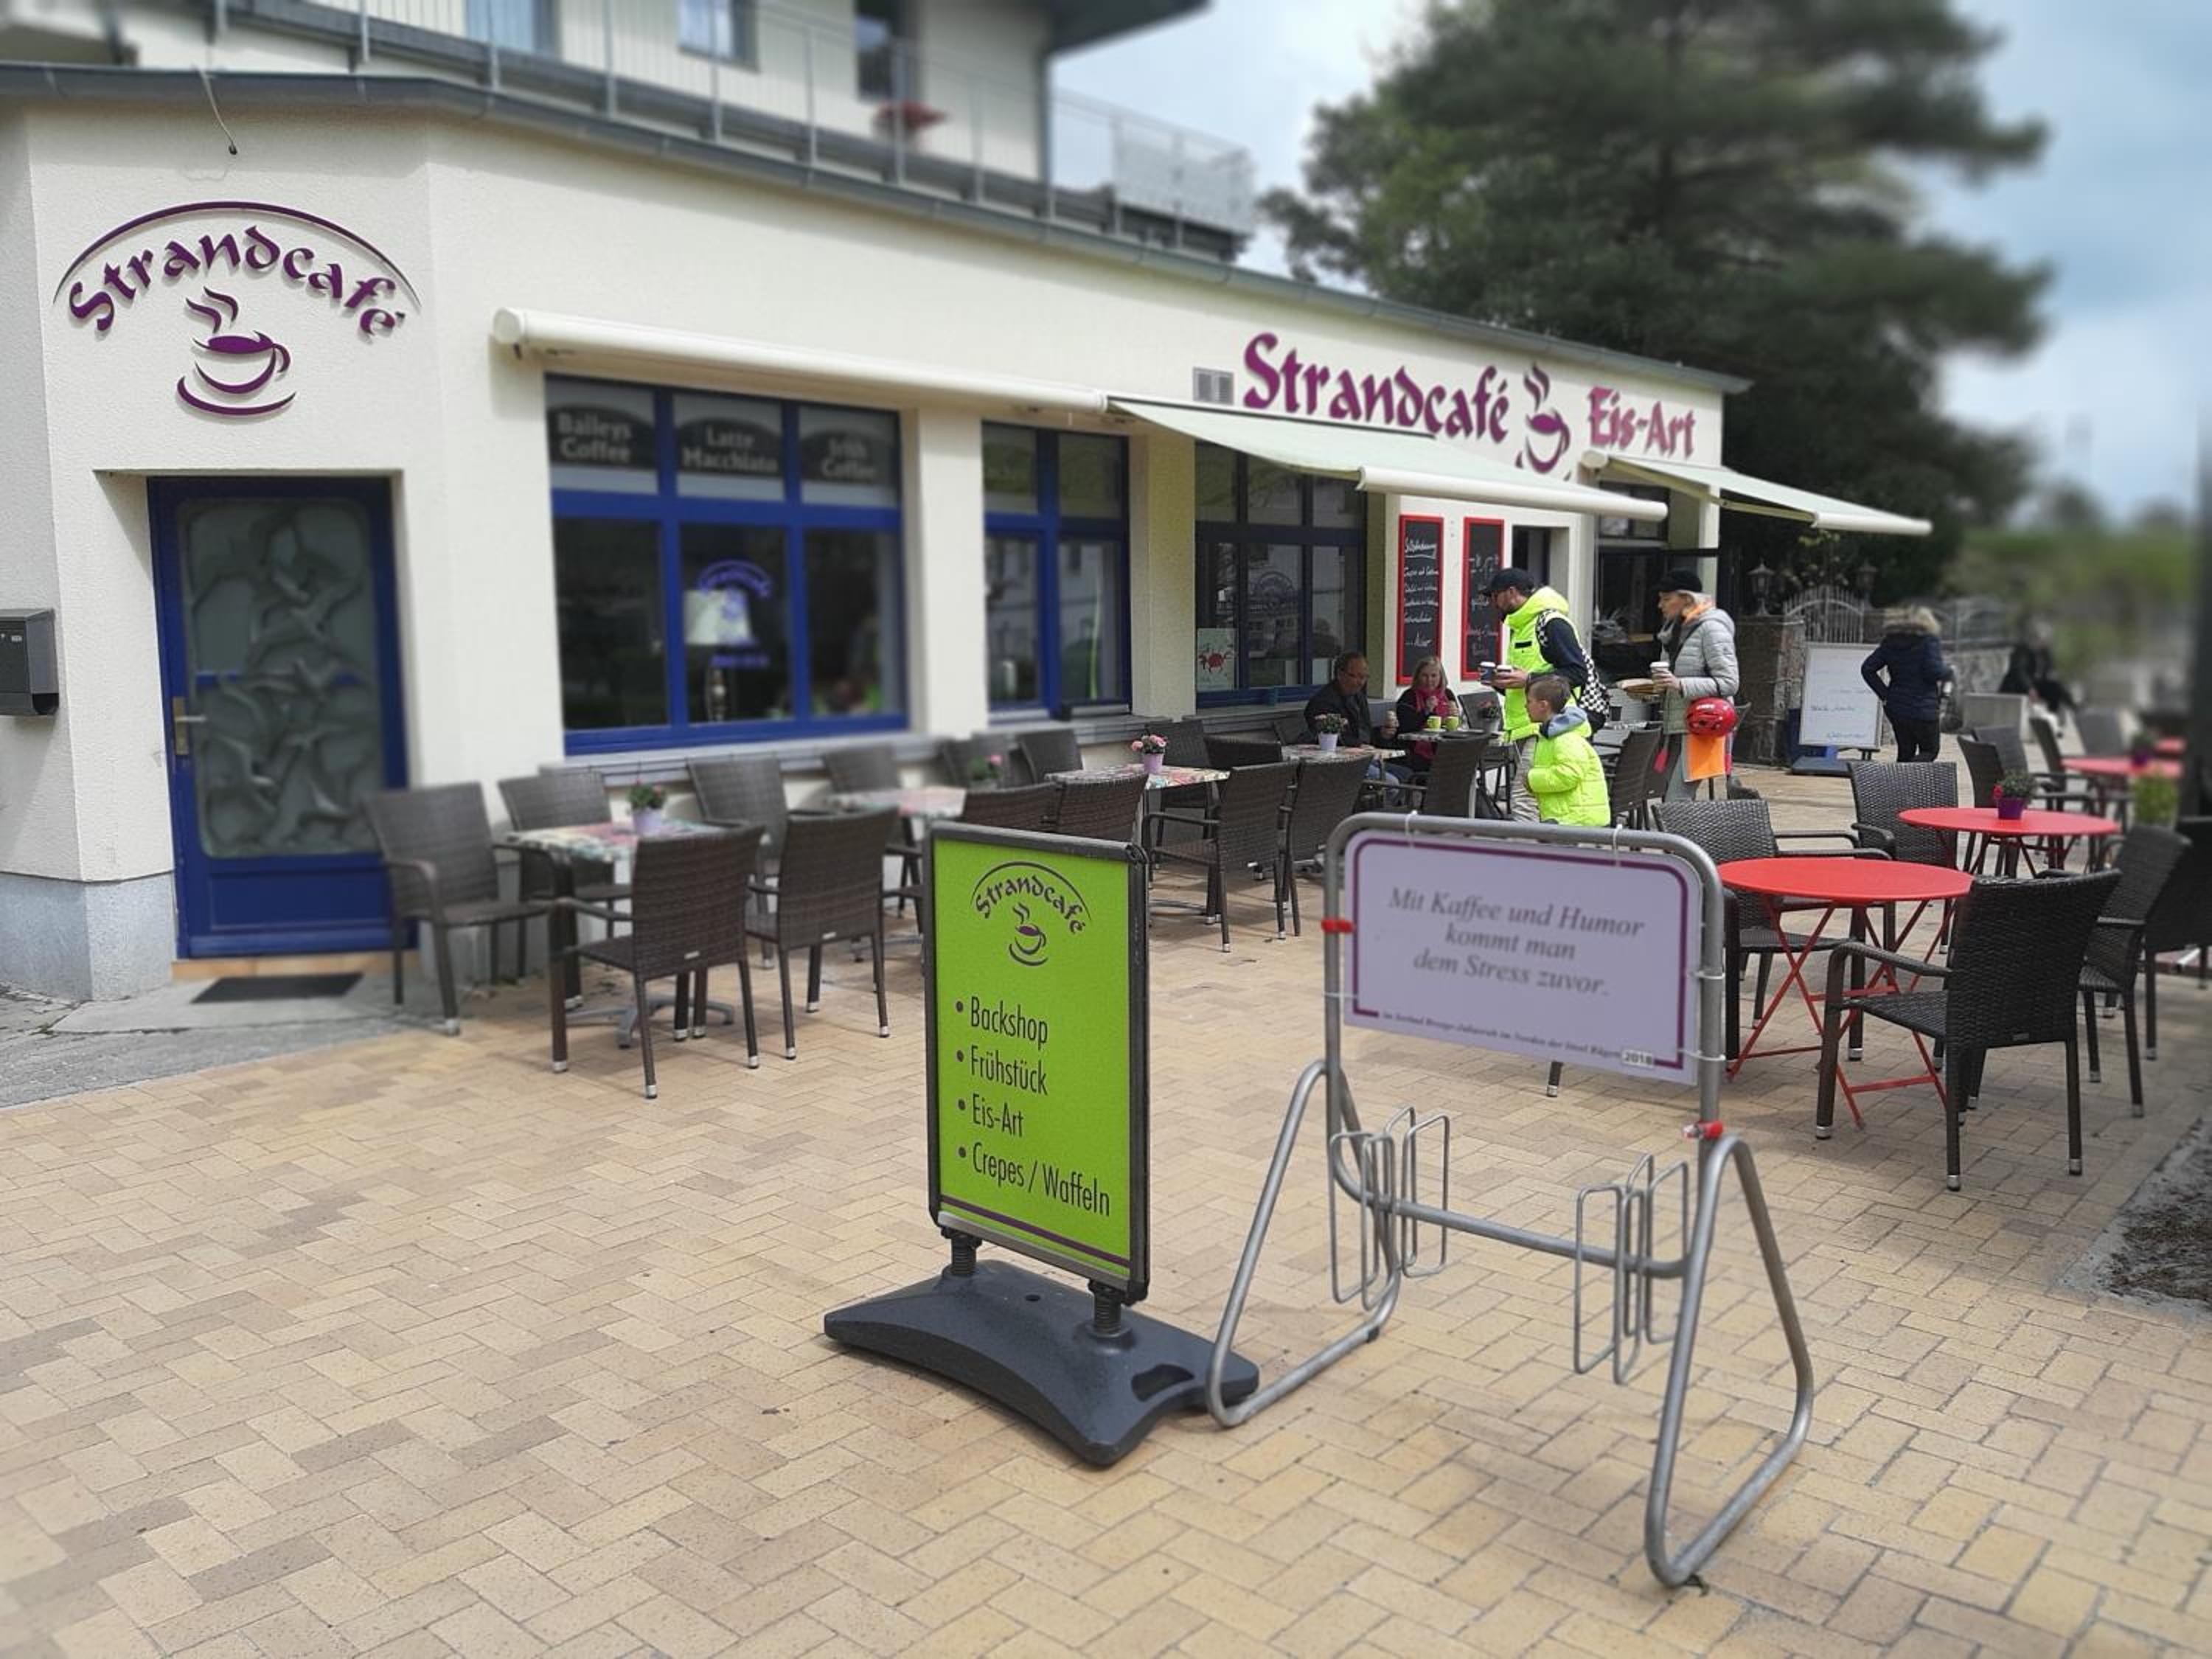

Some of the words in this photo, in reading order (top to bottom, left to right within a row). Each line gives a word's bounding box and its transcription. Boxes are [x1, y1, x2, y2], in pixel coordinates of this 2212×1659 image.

[69, 226, 406, 335] Strandcafé
[1243, 332, 1509, 442] Strandcafé
[557, 414, 632, 440] Baileys
[706, 425, 754, 448] Latte
[1587, 386, 1695, 458] Eis-Art
[560, 438, 631, 464] Coffee
[681, 447, 779, 473] Macchiato
[975, 874, 1086, 934] Strandcafé
[1388, 886, 1425, 911] Mit
[1430, 891, 1503, 922] Kaffee
[1508, 903, 1554, 926] und
[1558, 905, 1646, 937] Humor
[1444, 922, 1520, 953] kommt
[1525, 939, 1577, 960] man
[1413, 947, 1459, 975] dem
[1464, 954, 1531, 984] Stress
[1536, 970, 1610, 996] zuvor.
[971, 996, 1048, 1051] Backshop
[971, 1044, 1048, 1096] Frühstück
[973, 1093, 1024, 1137] Eis-Art
[973, 1142, 1025, 1188] Crepes
[1042, 1163, 1110, 1217] Waffeln
